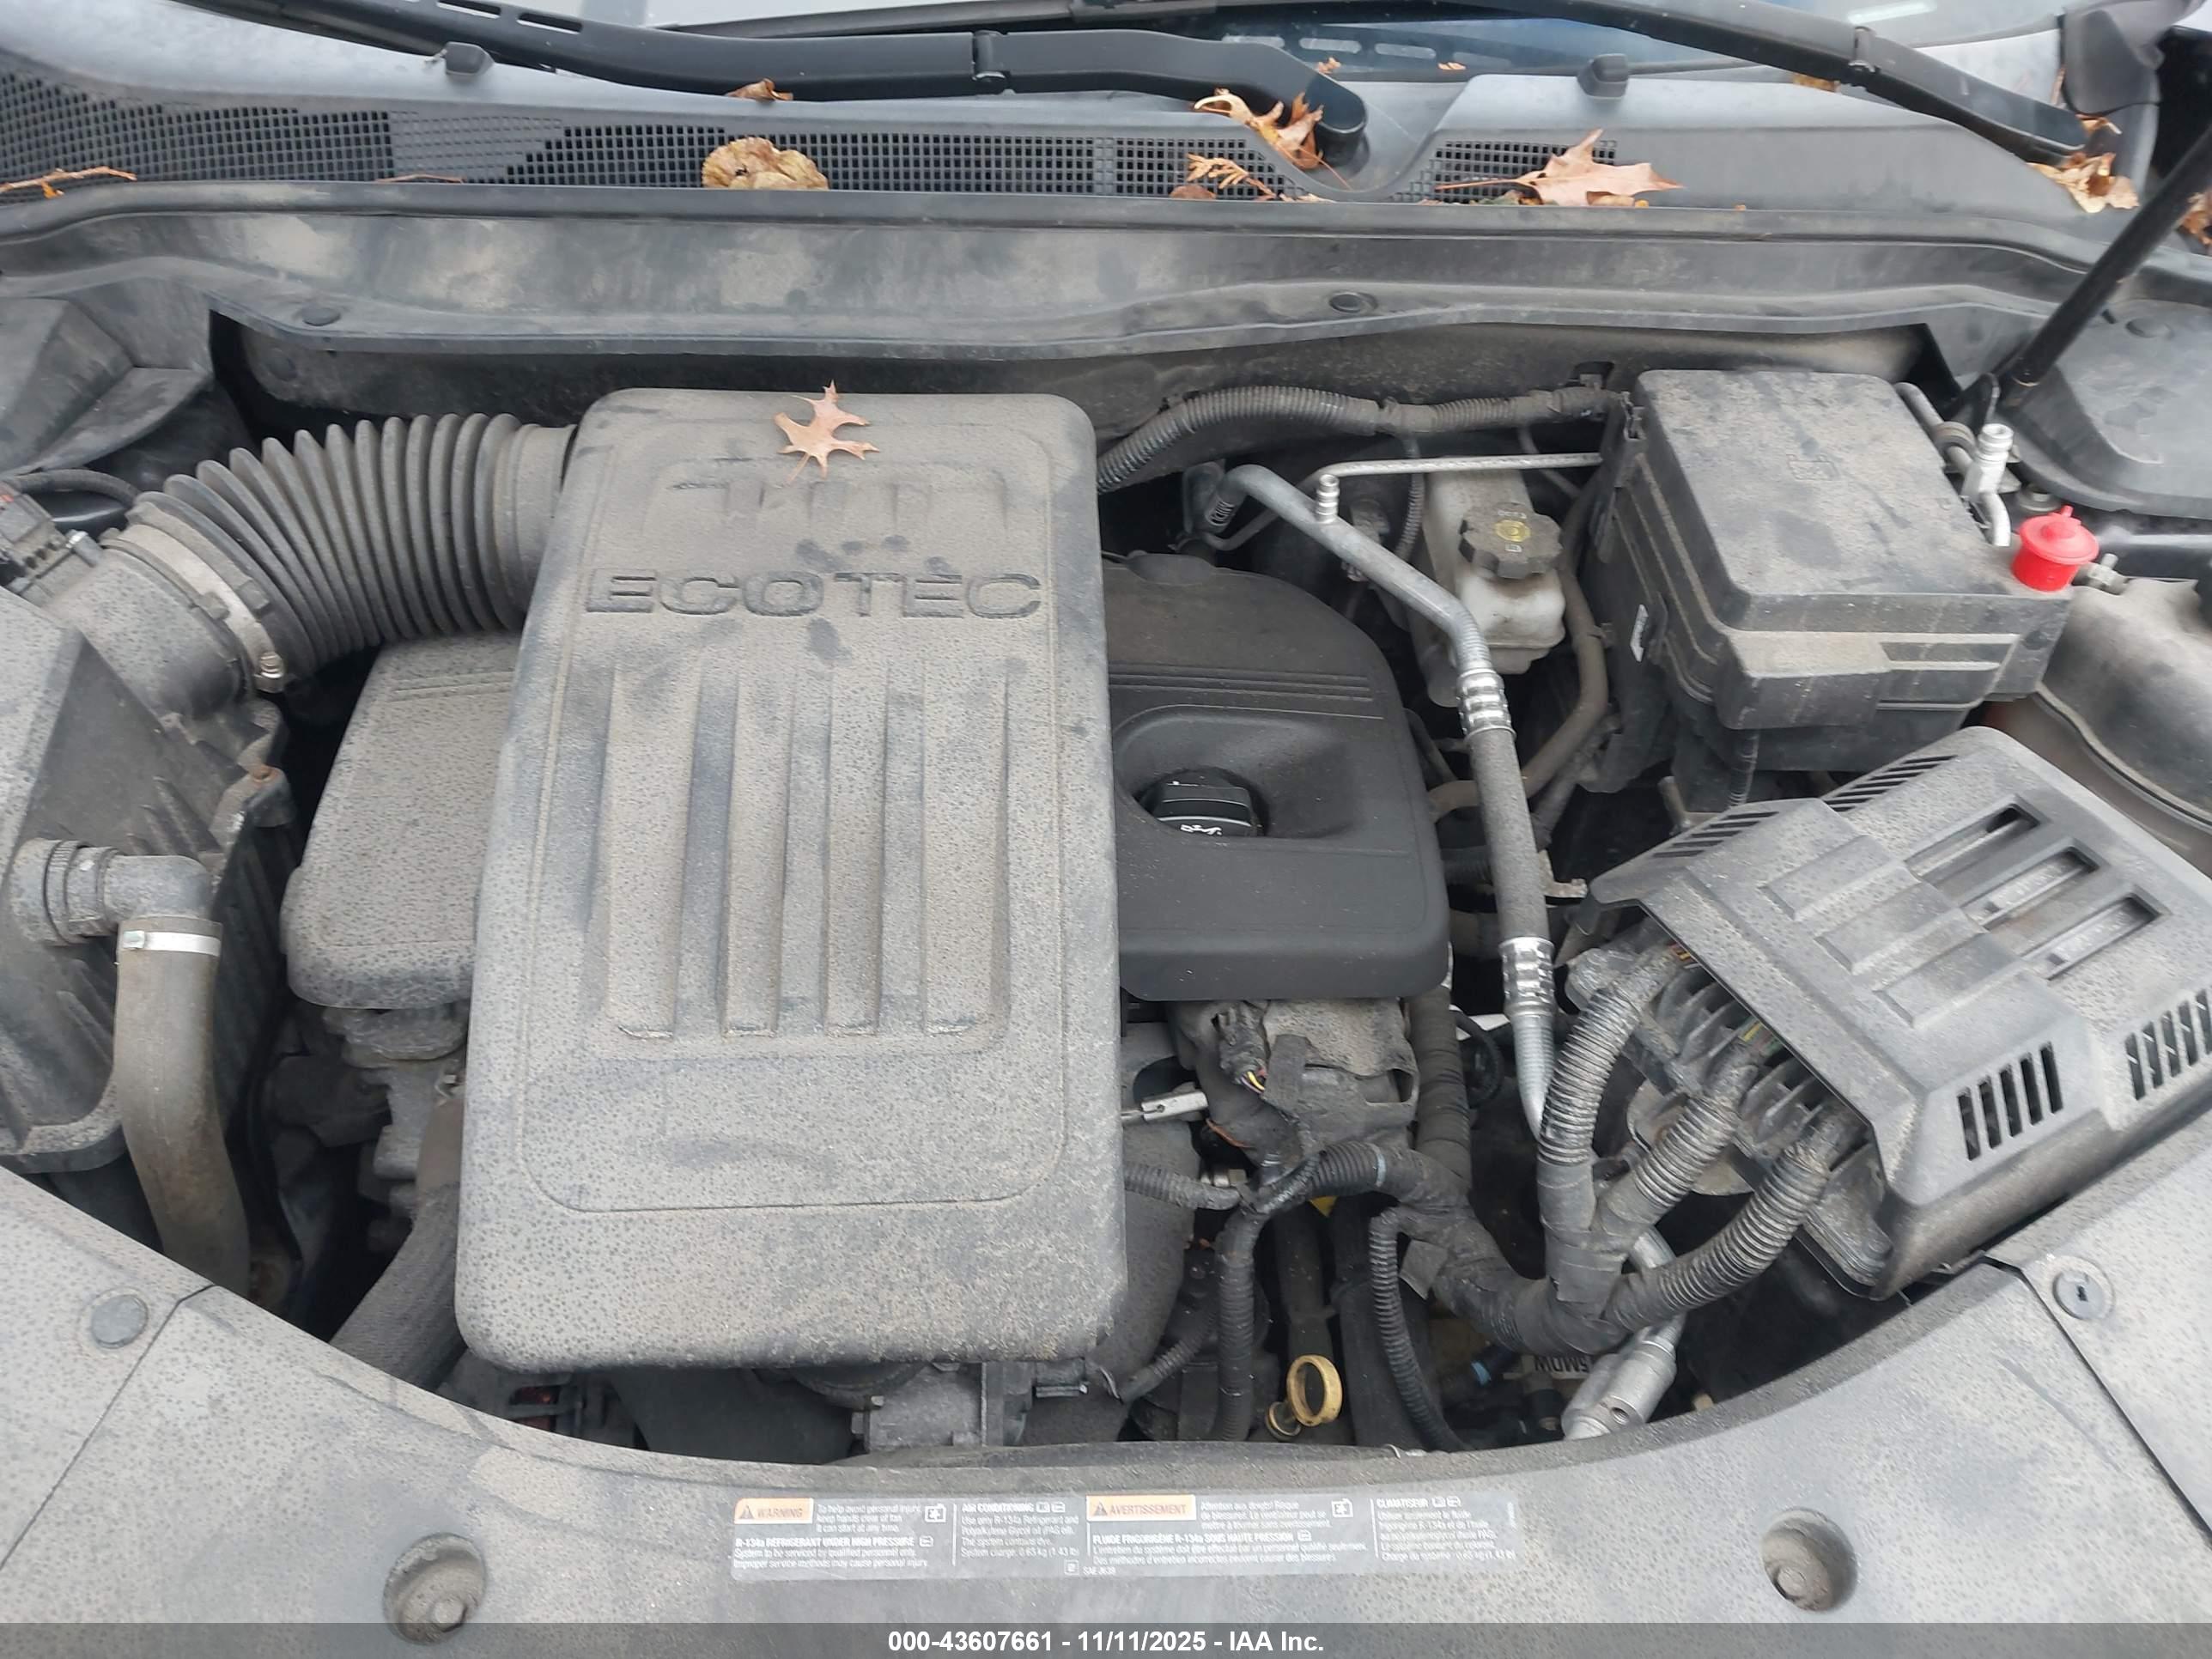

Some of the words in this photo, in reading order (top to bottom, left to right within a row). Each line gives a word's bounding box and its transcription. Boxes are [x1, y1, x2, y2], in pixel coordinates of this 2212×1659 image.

[586, 568, 1041, 619] ECOTEC
[845, 1504, 866, 1514] avoid
[866, 1504, 898, 1514] personal
[962, 1503, 976, 1512] AIR
[977, 1503, 1034, 1512] CONDITIONING
[1376, 1498, 1429, 1509] CLIMATISEUR
[757, 1508, 804, 1518] WARNING
[1109, 1504, 1187, 1515] AVERTISSEMENT
[994, 1516, 1021, 1525] R-134a
[735, 1537, 765, 1547] R-134a
[766, 1537, 822, 1547] REFRIGERANT
[822, 1536, 850, 1547] UNDER
[851, 1536, 872, 1547] HIGH
[872, 1536, 914, 1547] PRESSURE
[1092, 1534, 1121, 1545] FLUIDE
[1174, 1533, 1203, 1544] R-134a
[1204, 1533, 1226, 1543] SOUS
[1226, 1533, 1253, 1543] HAUTE
[1253, 1532, 1293, 1542] PRESSION
[734, 1548, 764, 1559] System
[783, 1548, 817, 1559] serviced
[828, 1548, 860, 1559] qualified
[861, 1548, 898, 1558] personnel
[733, 1559, 768, 1570] Improper
[769, 1559, 797, 1570] service
[797, 1559, 830, 1570] methods
[849, 1559, 872, 1569] cause
[872, 1559, 905, 1569] personal
[1082, 1566, 1097, 1576] SAE
